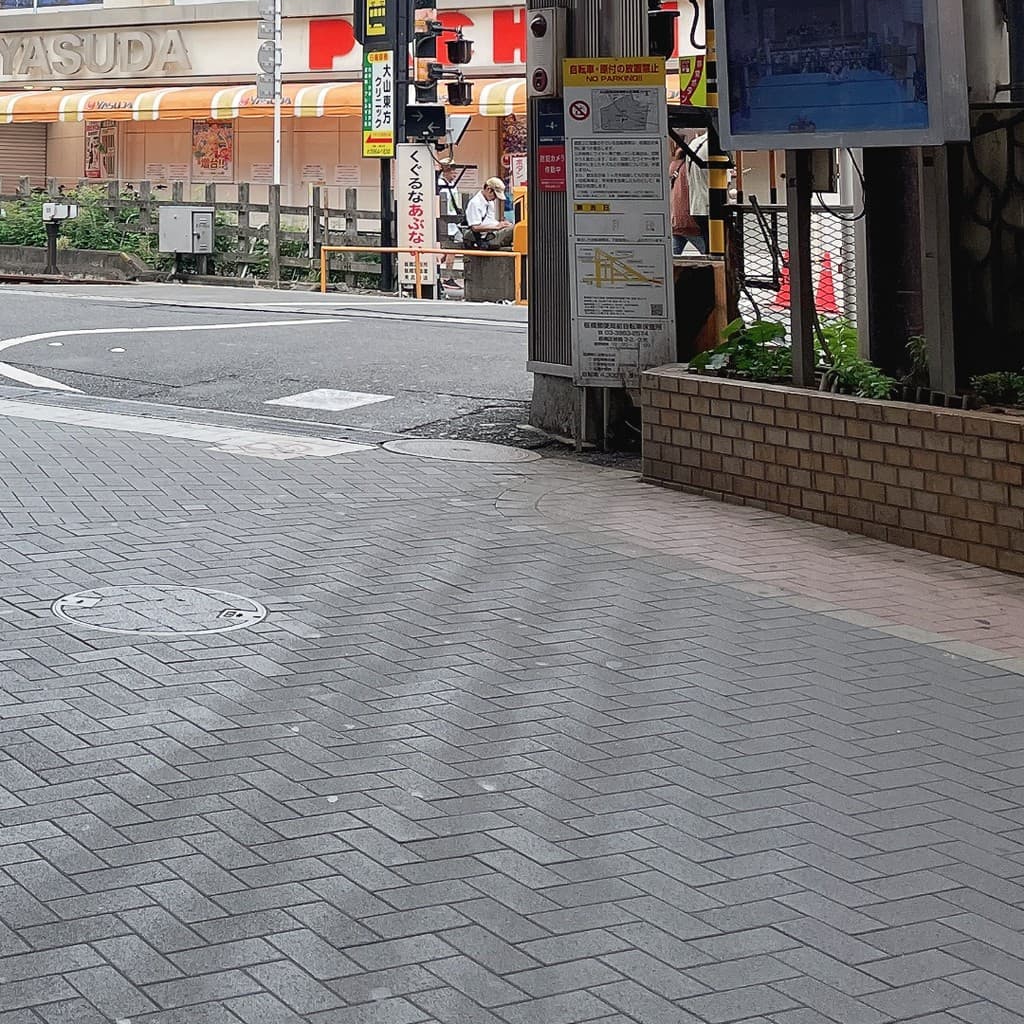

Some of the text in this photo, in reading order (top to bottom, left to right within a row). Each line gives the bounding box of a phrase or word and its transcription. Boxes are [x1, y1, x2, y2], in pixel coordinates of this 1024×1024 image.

[96, 100, 134, 110] YASUDA
[383, 63, 391, 124] 大山東方
